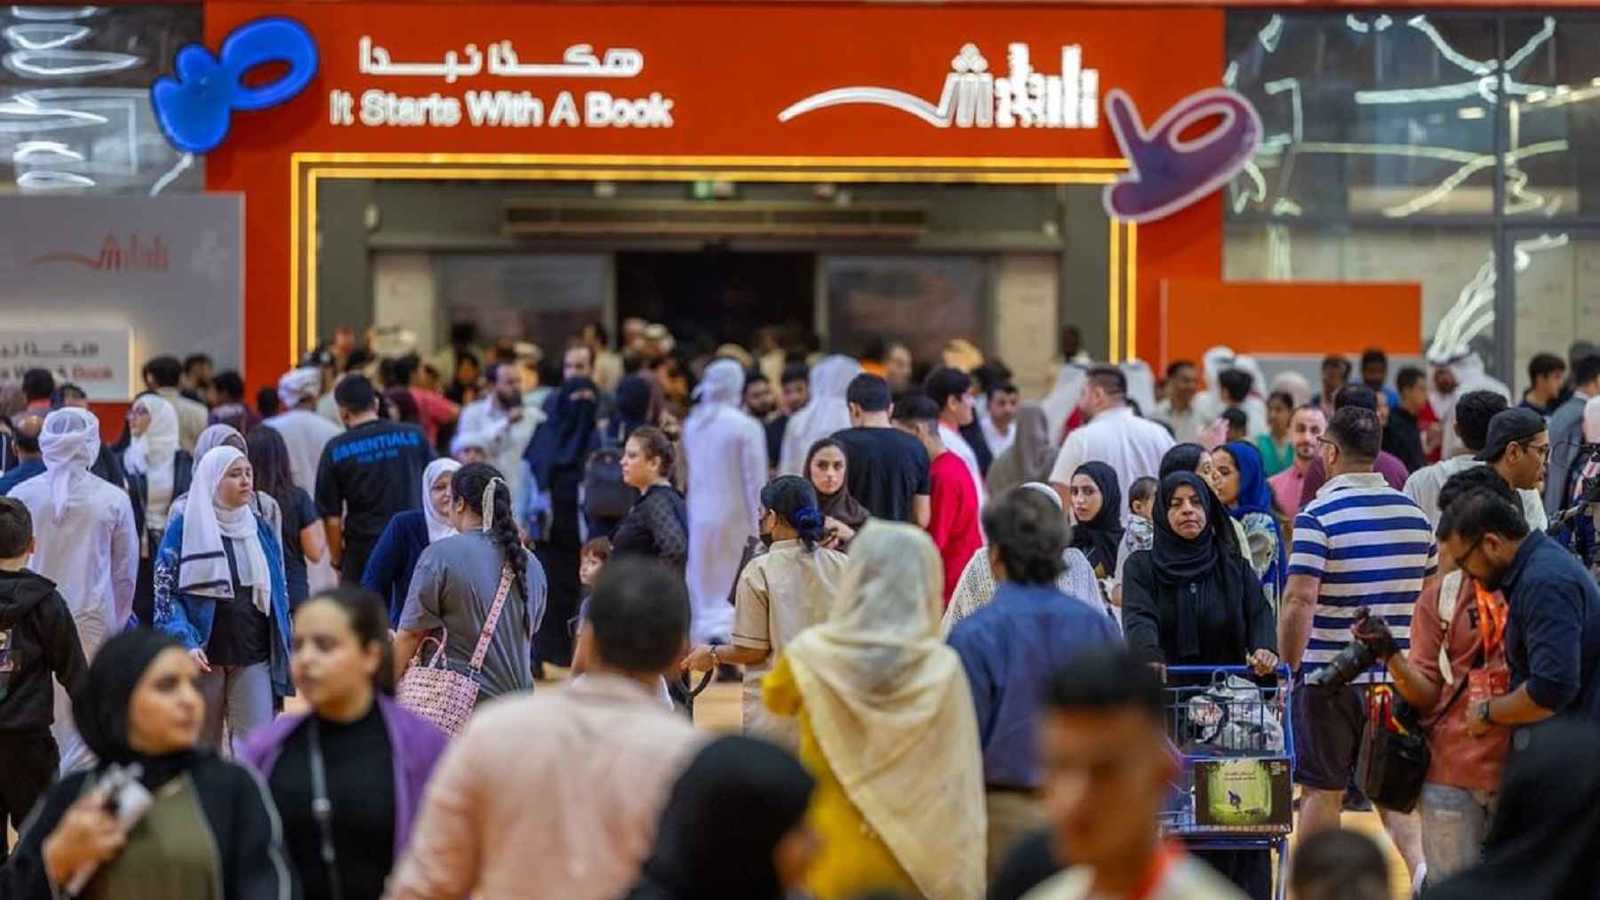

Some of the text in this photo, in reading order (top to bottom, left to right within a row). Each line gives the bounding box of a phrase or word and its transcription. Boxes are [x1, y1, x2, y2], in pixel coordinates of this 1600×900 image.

[330, 89, 675, 128] It Starts With A Book
